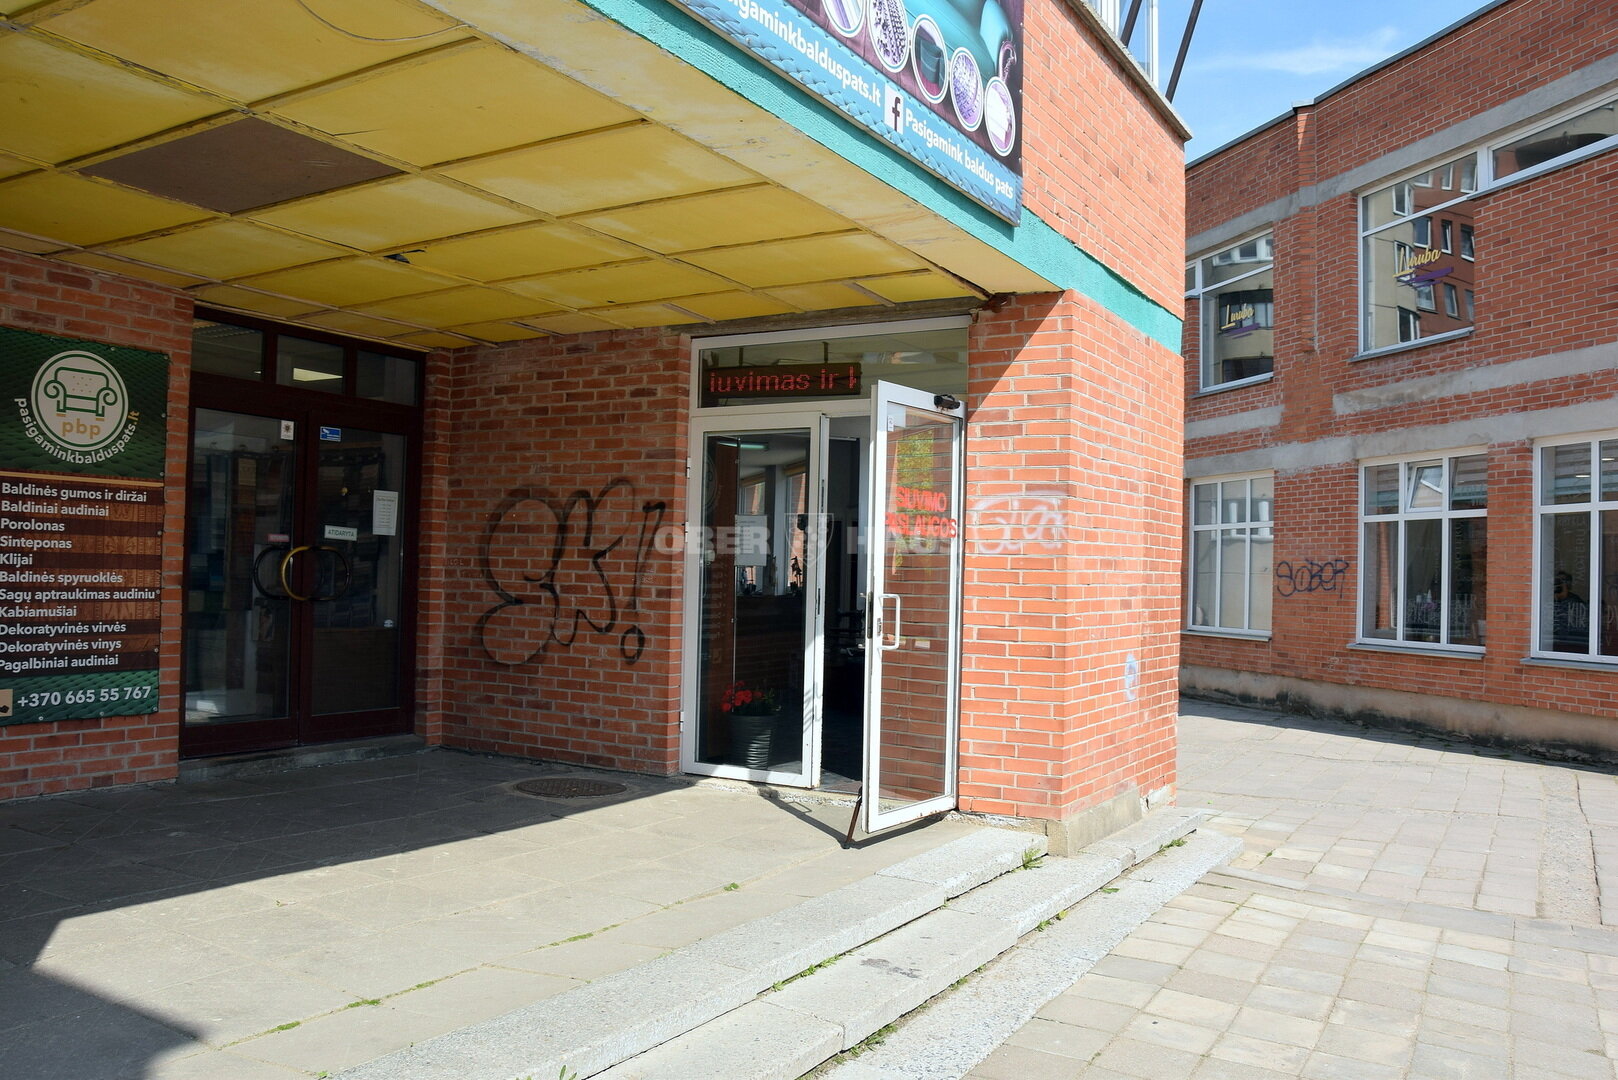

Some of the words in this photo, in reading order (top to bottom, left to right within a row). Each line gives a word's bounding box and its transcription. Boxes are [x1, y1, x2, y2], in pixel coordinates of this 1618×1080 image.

[905, 108, 963, 164] Pasigamink
[964, 150, 994, 185] baldus
[995, 177, 1014, 199] pats
[709, 369, 811, 393] iuvimas
[819, 368, 839, 390] ir
[14, 398, 140, 464] pasigaminkbalduspats.lt
[61, 418, 101, 439] pbp
[1, 482, 58, 498] Baldinės
[60, 486, 102, 500] gumos
[104, 489, 114, 500] ir
[115, 488, 147, 502] diržai
[1, 500, 58, 515] Baldiniai
[60, 503, 109, 517] audiniai
[0, 517, 65, 532] Porolonas
[327, 528, 355, 538] ATIDARYTA
[0, 535, 72, 550] Sinteponas
[0, 552, 33, 568] Klijai
[0, 571, 55, 583] Baldinės
[57, 571, 123, 587] spyruoklės
[0, 588, 32, 602] Sagų
[35, 589, 110, 602] aptraukimas
[112, 588, 155, 600] audiniu
[0, 605, 77, 618] Kabiamušiai
[0, 622, 89, 637] Dekoratyvinės
[92, 621, 127, 633] virvės
[0, 640, 89, 654] Dekoratyvinės
[91, 640, 122, 653] vinys
[71, 654, 119, 668] audiniai
[17, 690, 61, 707] +370
[65, 688, 95, 705] 665
[99, 686, 120, 702] 55
[123, 686, 151, 700] 767
